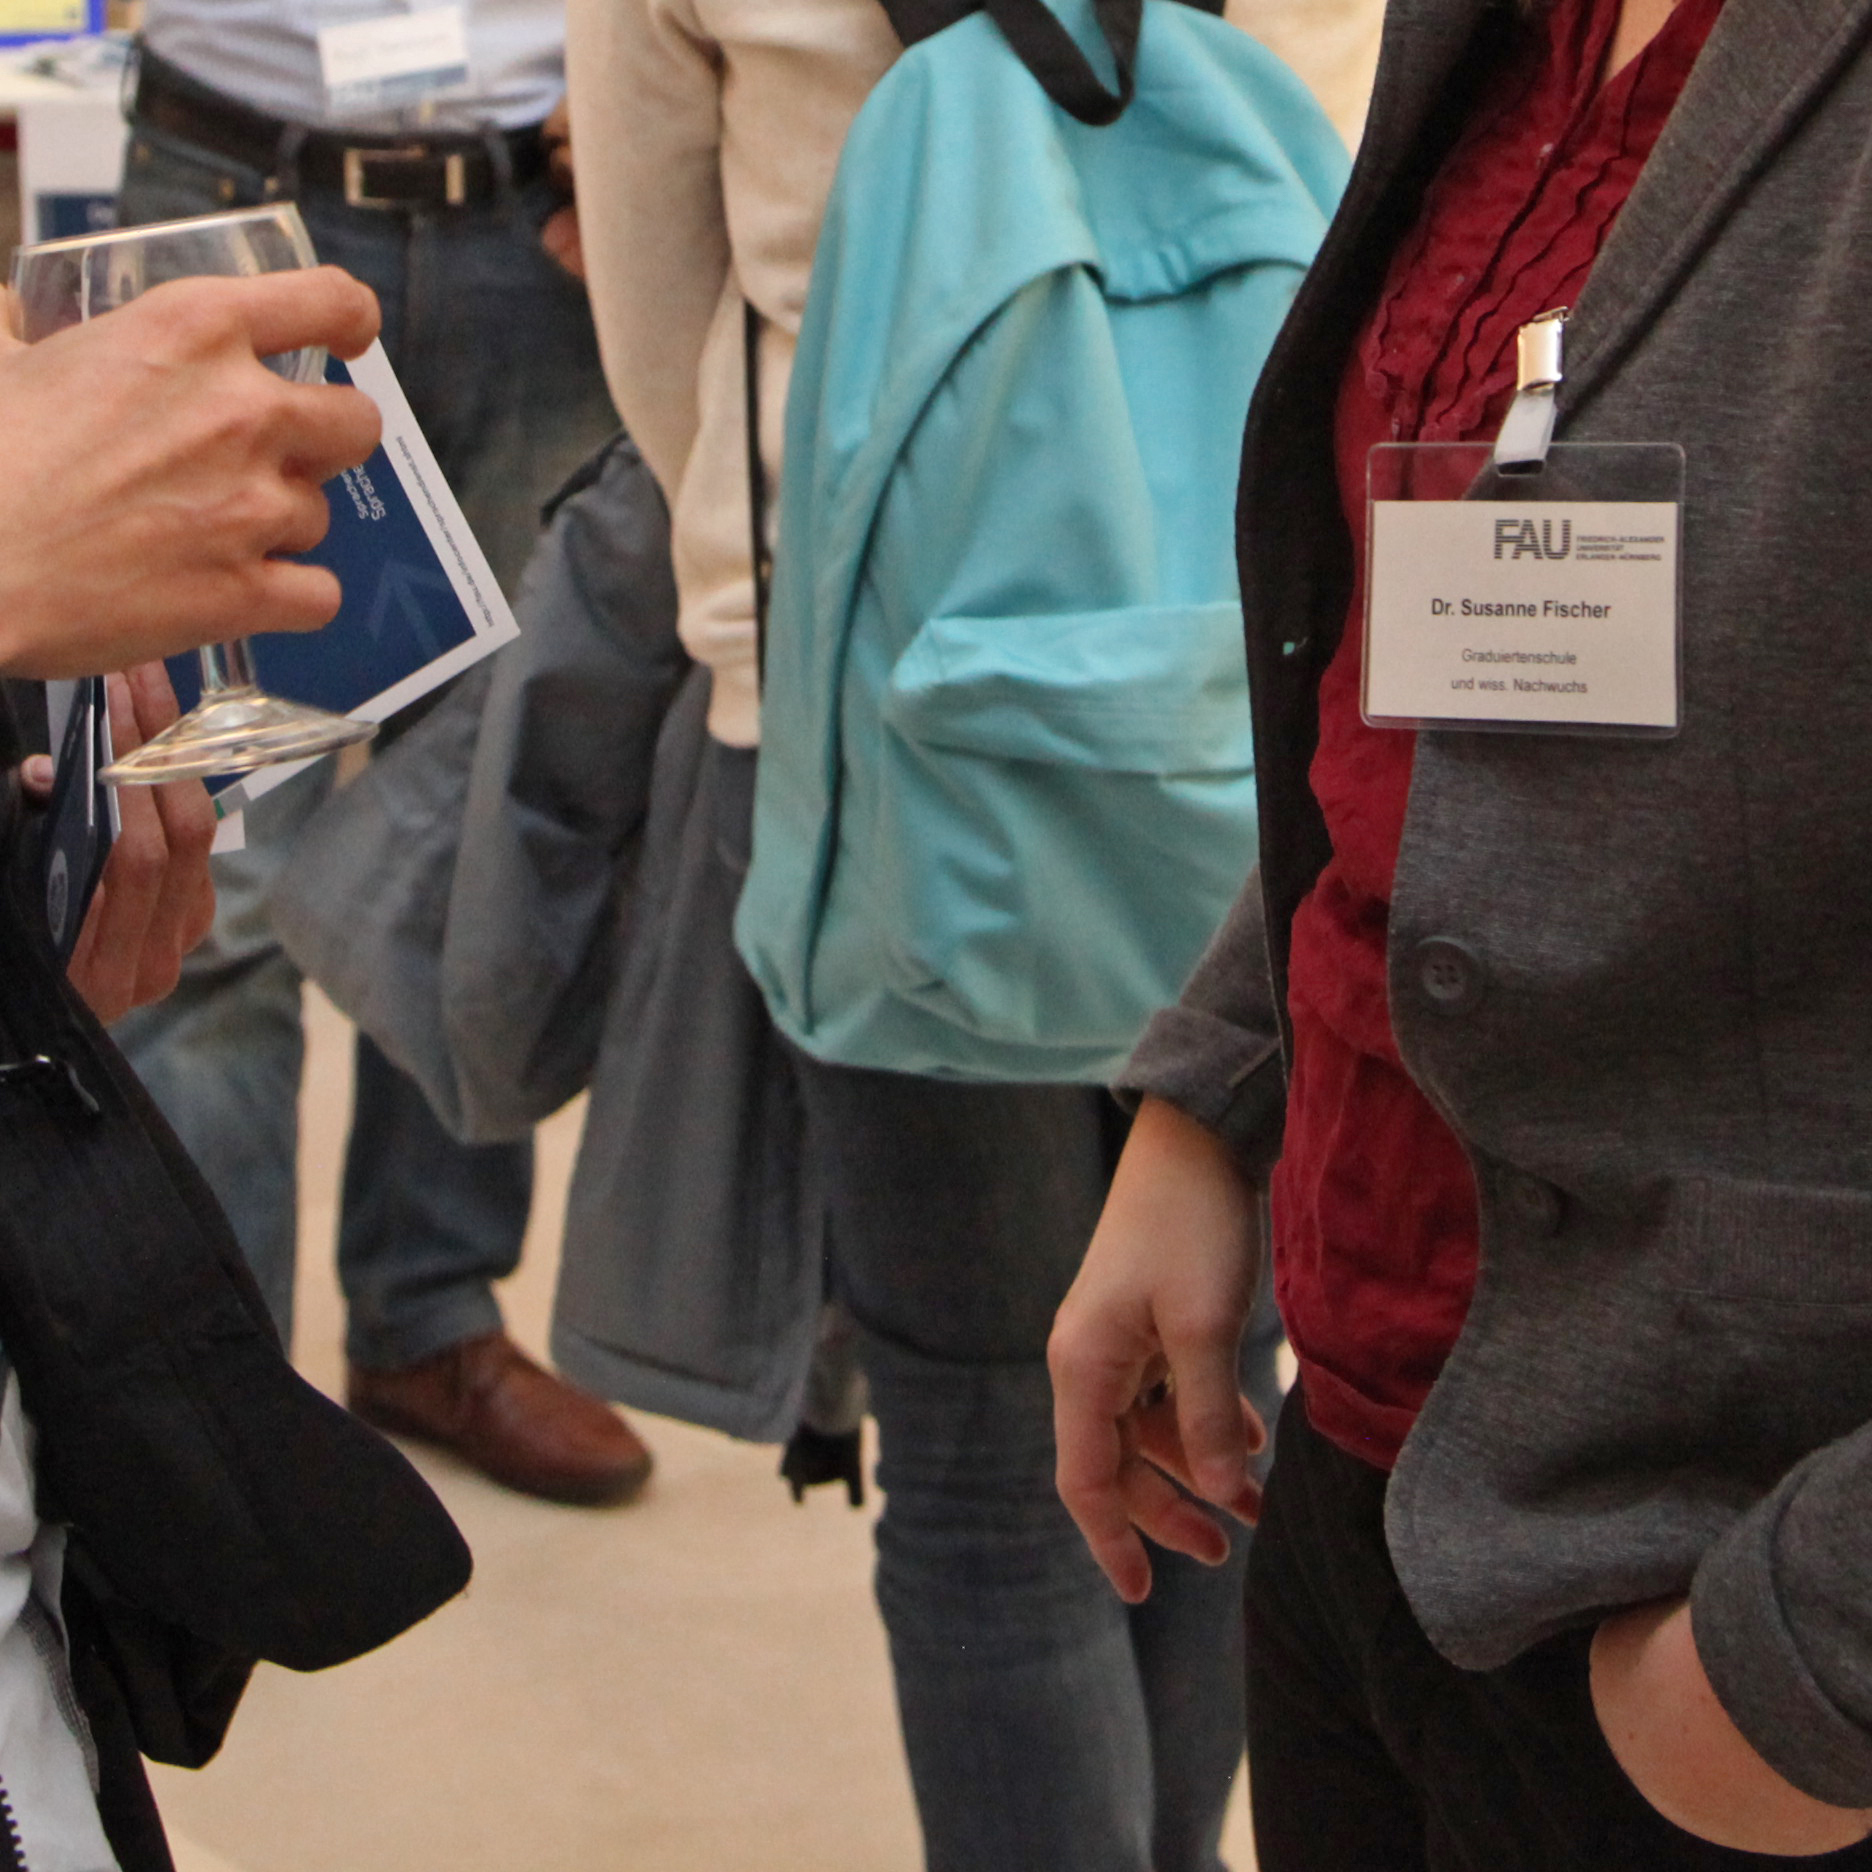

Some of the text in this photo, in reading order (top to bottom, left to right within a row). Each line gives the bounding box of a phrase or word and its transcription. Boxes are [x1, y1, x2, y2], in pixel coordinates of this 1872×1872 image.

[1494, 519, 1572, 560] FAU
[1431, 598, 1612, 619] Dr. Susanne Fischer
[1462, 648, 1578, 665] Graduiertenschule
[1451, 677, 1589, 694] und wiss. Nachwuchs
